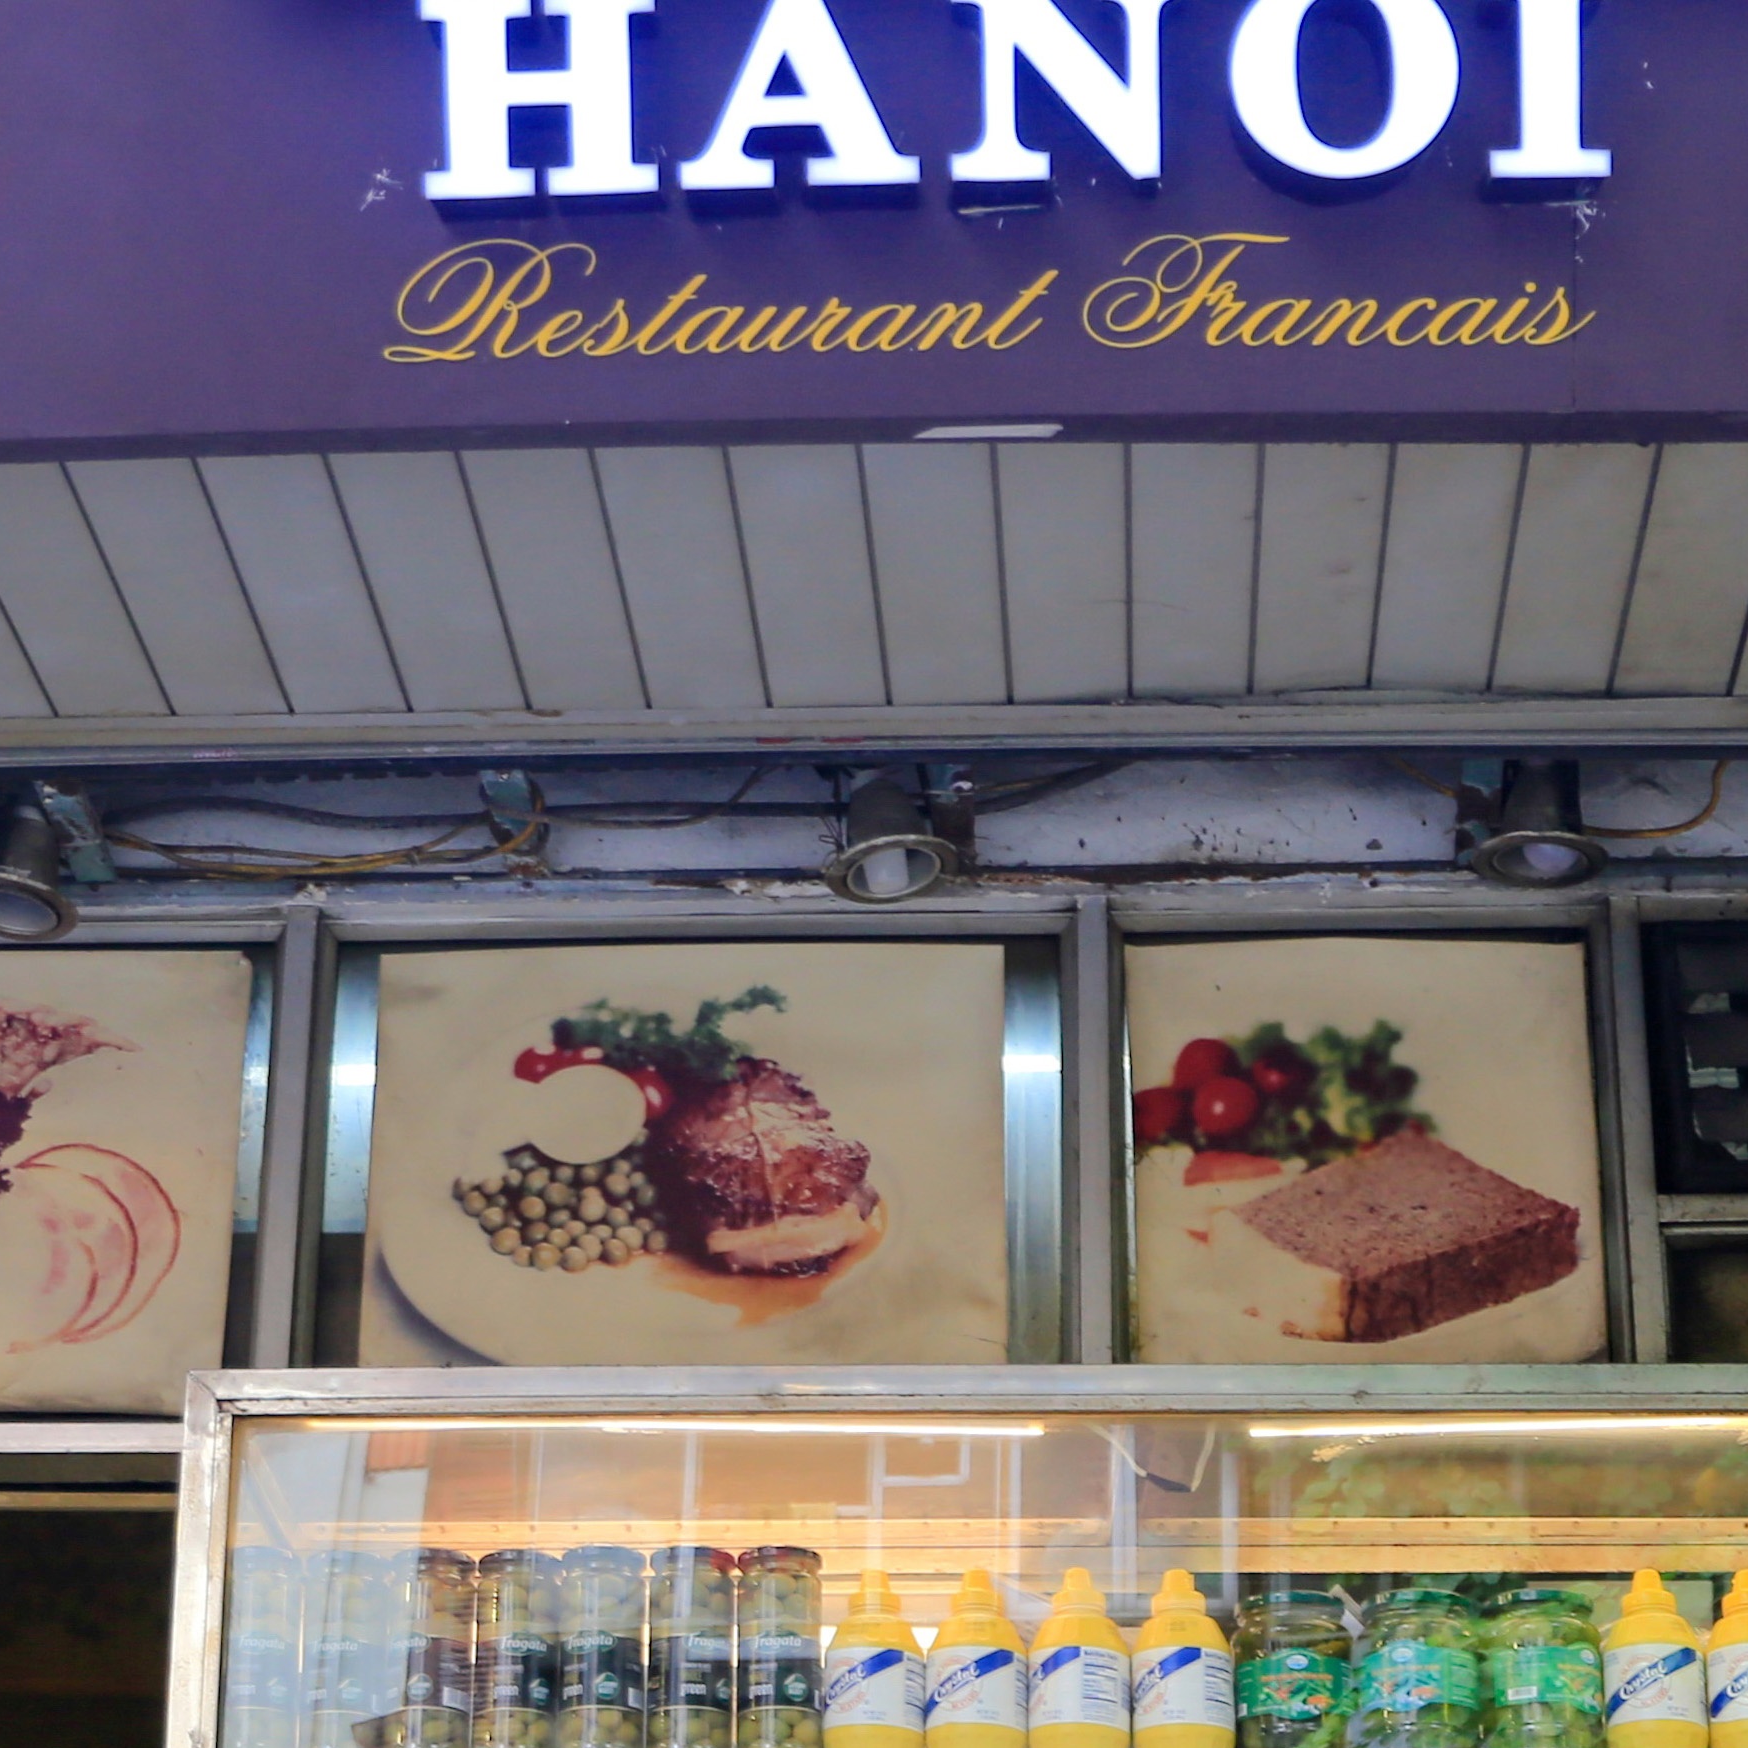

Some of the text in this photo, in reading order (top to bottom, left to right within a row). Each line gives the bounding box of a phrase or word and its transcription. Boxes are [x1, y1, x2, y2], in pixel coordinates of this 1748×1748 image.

[423, 0, 1614, 200] HANOI
[382, 234, 1598, 365] Restaurant Francais
[501, 1635, 547, 1651] fragata
[567, 1632, 614, 1648] fragata
[754, 1632, 802, 1648] fragata
[934, 1660, 980, 1702] Crystal
[1619, 1661, 1668, 1700] Crystal
